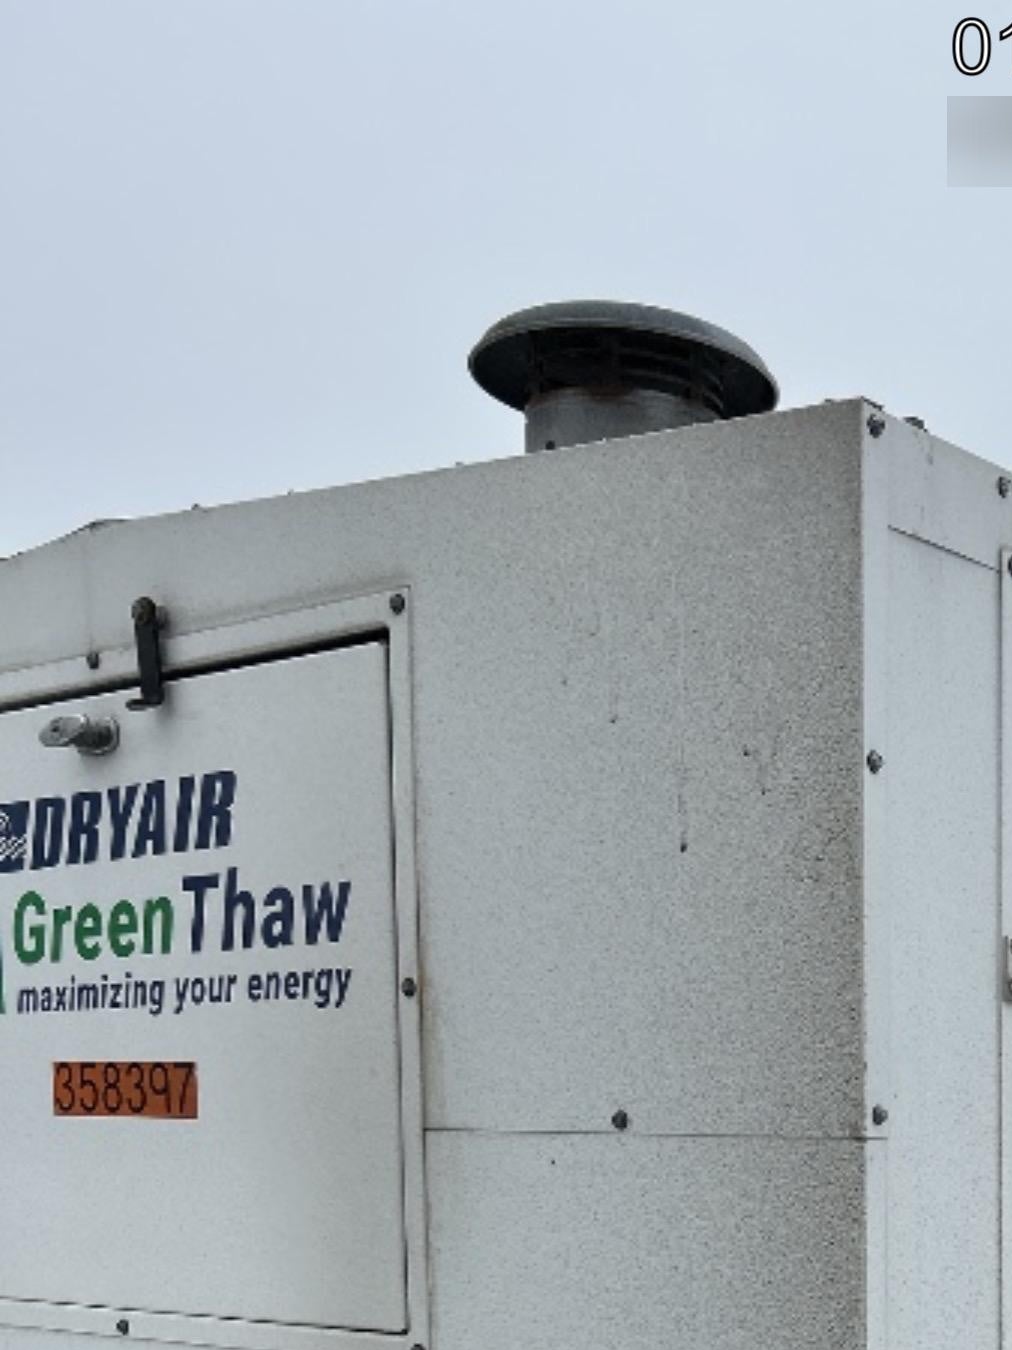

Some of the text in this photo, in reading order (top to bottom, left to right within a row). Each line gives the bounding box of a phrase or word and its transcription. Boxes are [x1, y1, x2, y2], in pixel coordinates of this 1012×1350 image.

[29, 770, 237, 871] DRYAIR
[16, 967, 352, 1017] maximizing your energy
[55, 1062, 197, 1115] 358397
